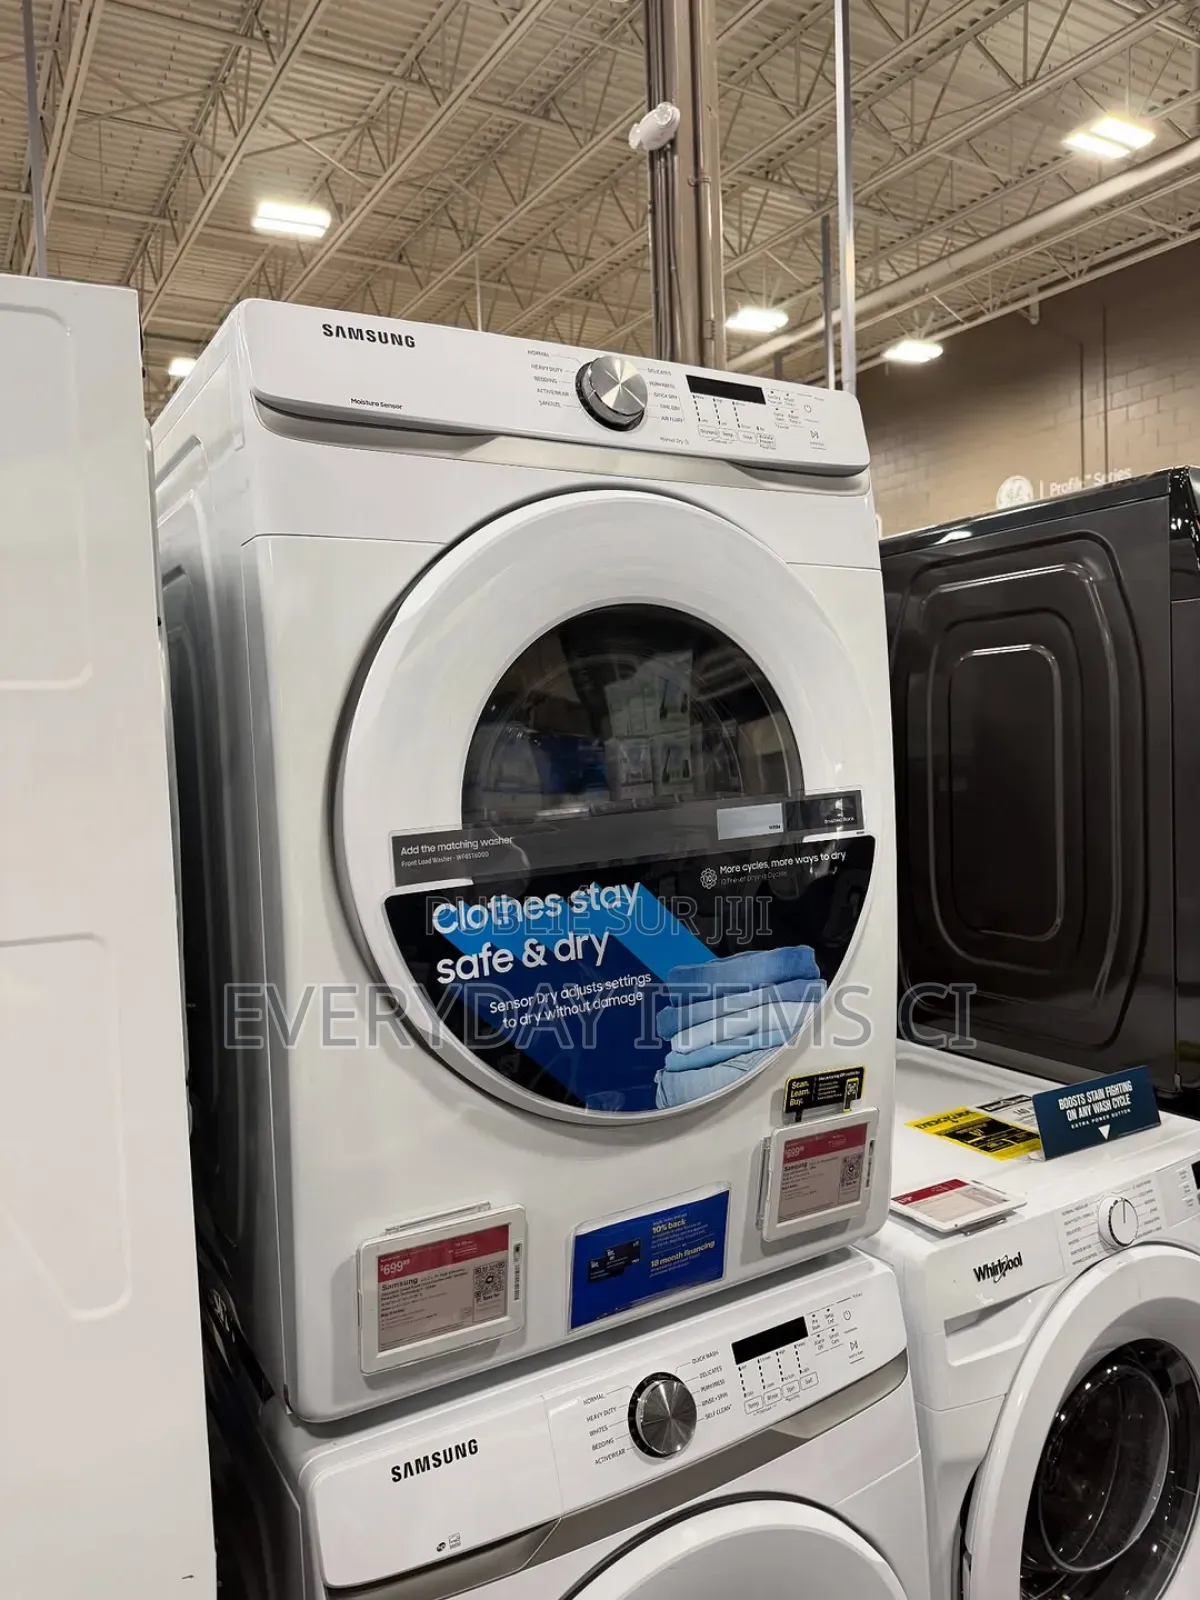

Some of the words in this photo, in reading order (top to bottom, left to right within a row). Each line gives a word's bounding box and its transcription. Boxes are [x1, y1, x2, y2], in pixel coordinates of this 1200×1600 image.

[321, 323, 416, 348] SAMSUNG
[527, 349, 550, 358] NORMAL
[533, 375, 558, 384] BEDDING
[536, 387, 570, 397] ACTIVEWEAR
[350, 398, 380, 408] Moisture
[380, 402, 403, 411] Sensor
[400, 844, 420, 856] Add
[420, 843, 436, 854] the
[437, 839, 479, 851] matching
[480, 836, 513, 847] washer
[401, 859, 417, 868] Front
[418, 857, 432, 865] Load
[720, 865, 741, 875] More
[741, 860, 770, 873] cycles,
[771, 858, 794, 868] more
[794, 854, 819, 867] ways
[820, 852, 830, 861] to
[830, 851, 847, 862] dry
[432, 893, 563, 934] Clothes
[570, 881, 641, 916] stay
[436, 942, 514, 985] safe
[522, 938, 548, 968] &
[553, 931, 610, 967] dry
[489, 996, 534, 1014] Sensor
[536, 991, 558, 1005] Dry
[560, 982, 604, 1000] adjusts
[604, 973, 652, 990] settings
[502, 1016, 517, 1029] to
[519, 1012, 542, 1026] dry
[544, 1003, 593, 1020] without
[593, 991, 643, 1006] damage
[1058, 1093, 1087, 1110] BOOSTS
[1086, 1088, 1106, 1103] STAIN
[1105, 1080, 1133, 1097] FIGHTING
[1066, 1109, 1078, 1122] ON
[1078, 1104, 1092, 1119] ANY
[1092, 1099, 1112, 1114] WASH
[1112, 1093, 1132, 1108] CYCLE
[1070, 1120, 1090, 1130] EXTRA
[1091, 1114, 1110, 1123] POWER
[651, 1223, 668, 1234] 10%
[659, 1252, 683, 1264] month
[683, 1240, 716, 1257] financing
[973, 1252, 1023, 1283] Whirlpool
[381, 1277, 418, 1291] Samsung
[691, 1355, 706, 1364] QUICK
[699, 1365, 723, 1379] DELICATES
[583, 1392, 606, 1406] NORMAL
[586, 1411, 603, 1423] HEAVY
[603, 1406, 617, 1417] DUTY
[705, 1410, 716, 1420] SELF
[589, 1425, 609, 1437] WHITES
[591, 1437, 615, 1451] BEDDING
[391, 1439, 479, 1483] SAMSUNG
[595, 1448, 626, 1465] ACTIVEWEAR
